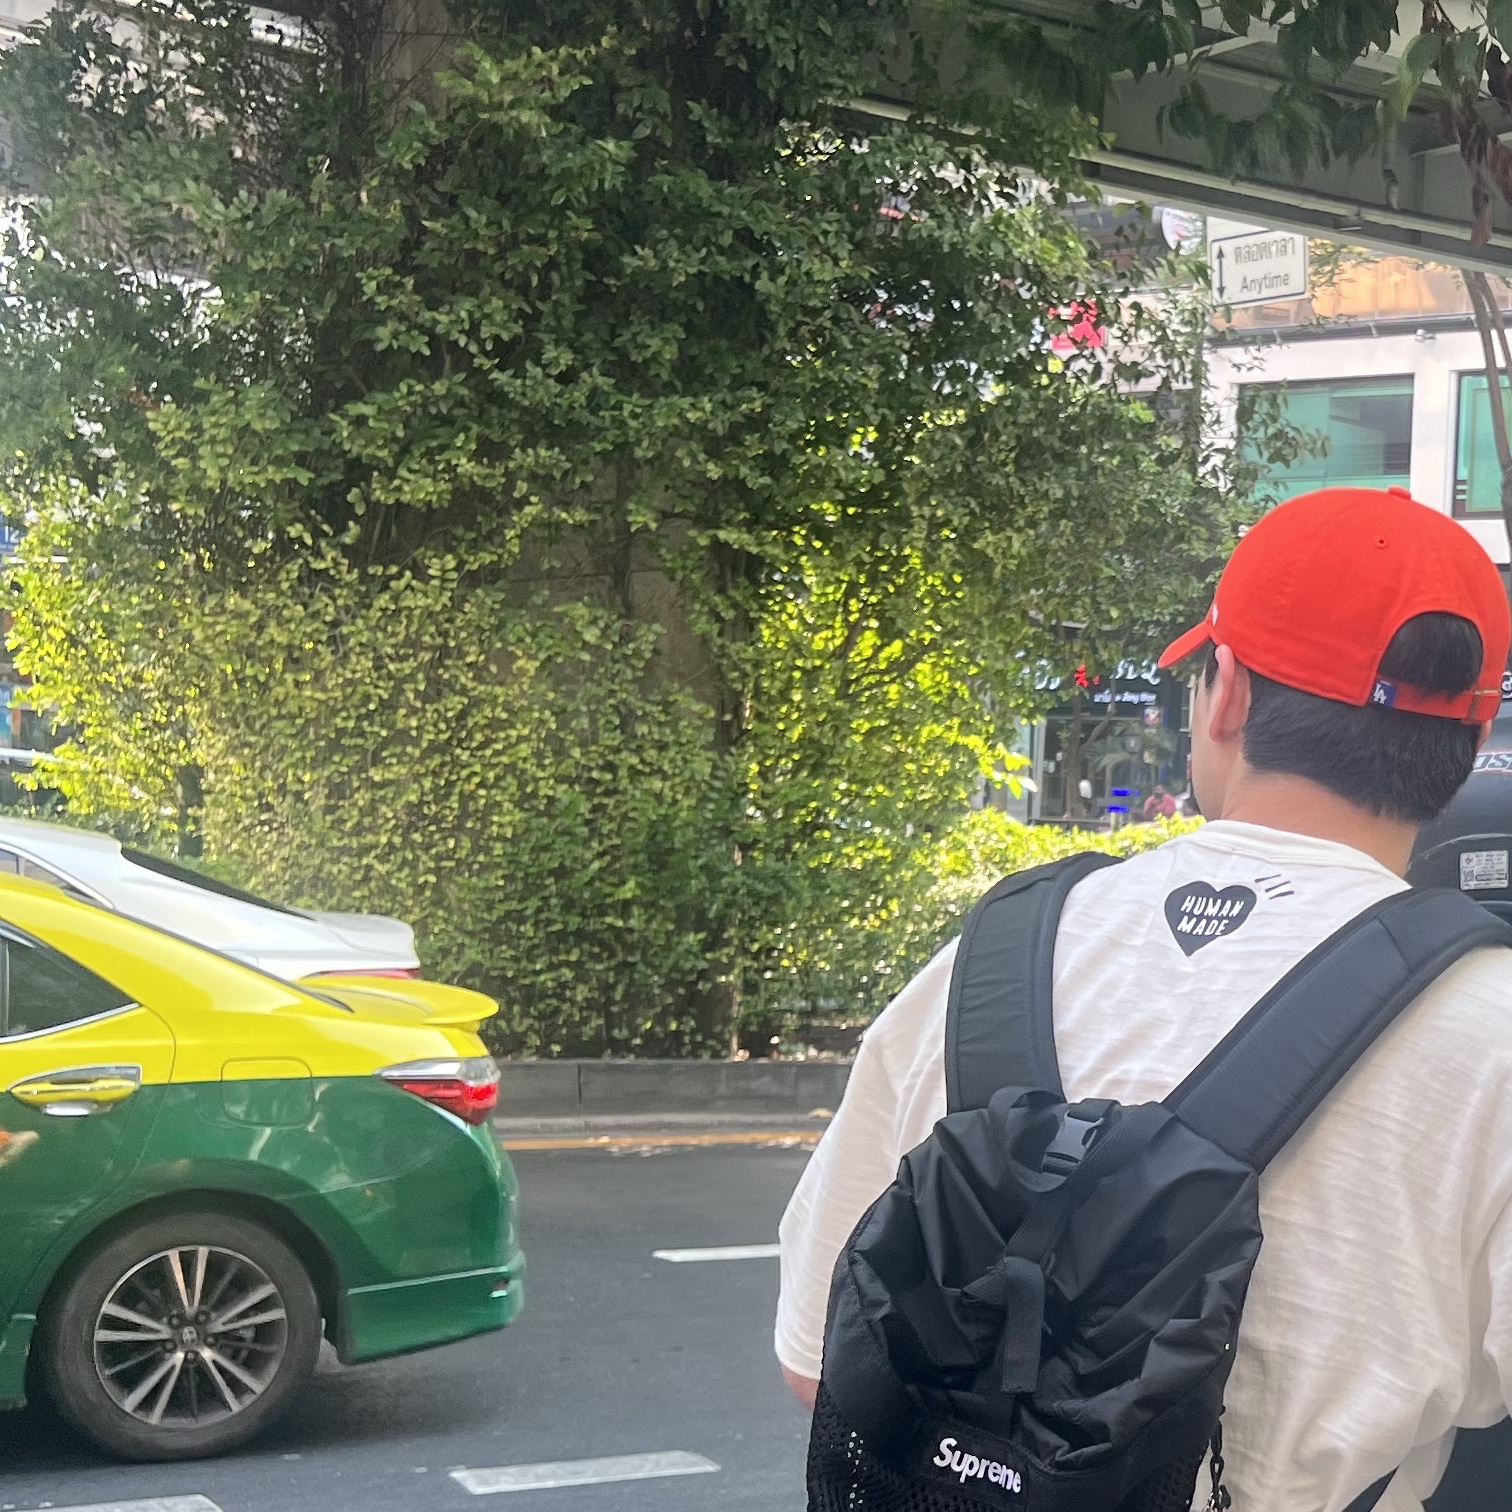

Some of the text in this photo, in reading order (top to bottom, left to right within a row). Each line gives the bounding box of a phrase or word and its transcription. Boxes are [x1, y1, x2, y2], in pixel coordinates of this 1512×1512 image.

[1233, 237, 1297, 265] ตลอดเวลา
[1240, 272, 1290, 295] Anytime
[1180, 895, 1245, 918] HUMAN
[1177, 915, 1230, 936] MADE
[932, 1437, 1022, 1493] Supreme
